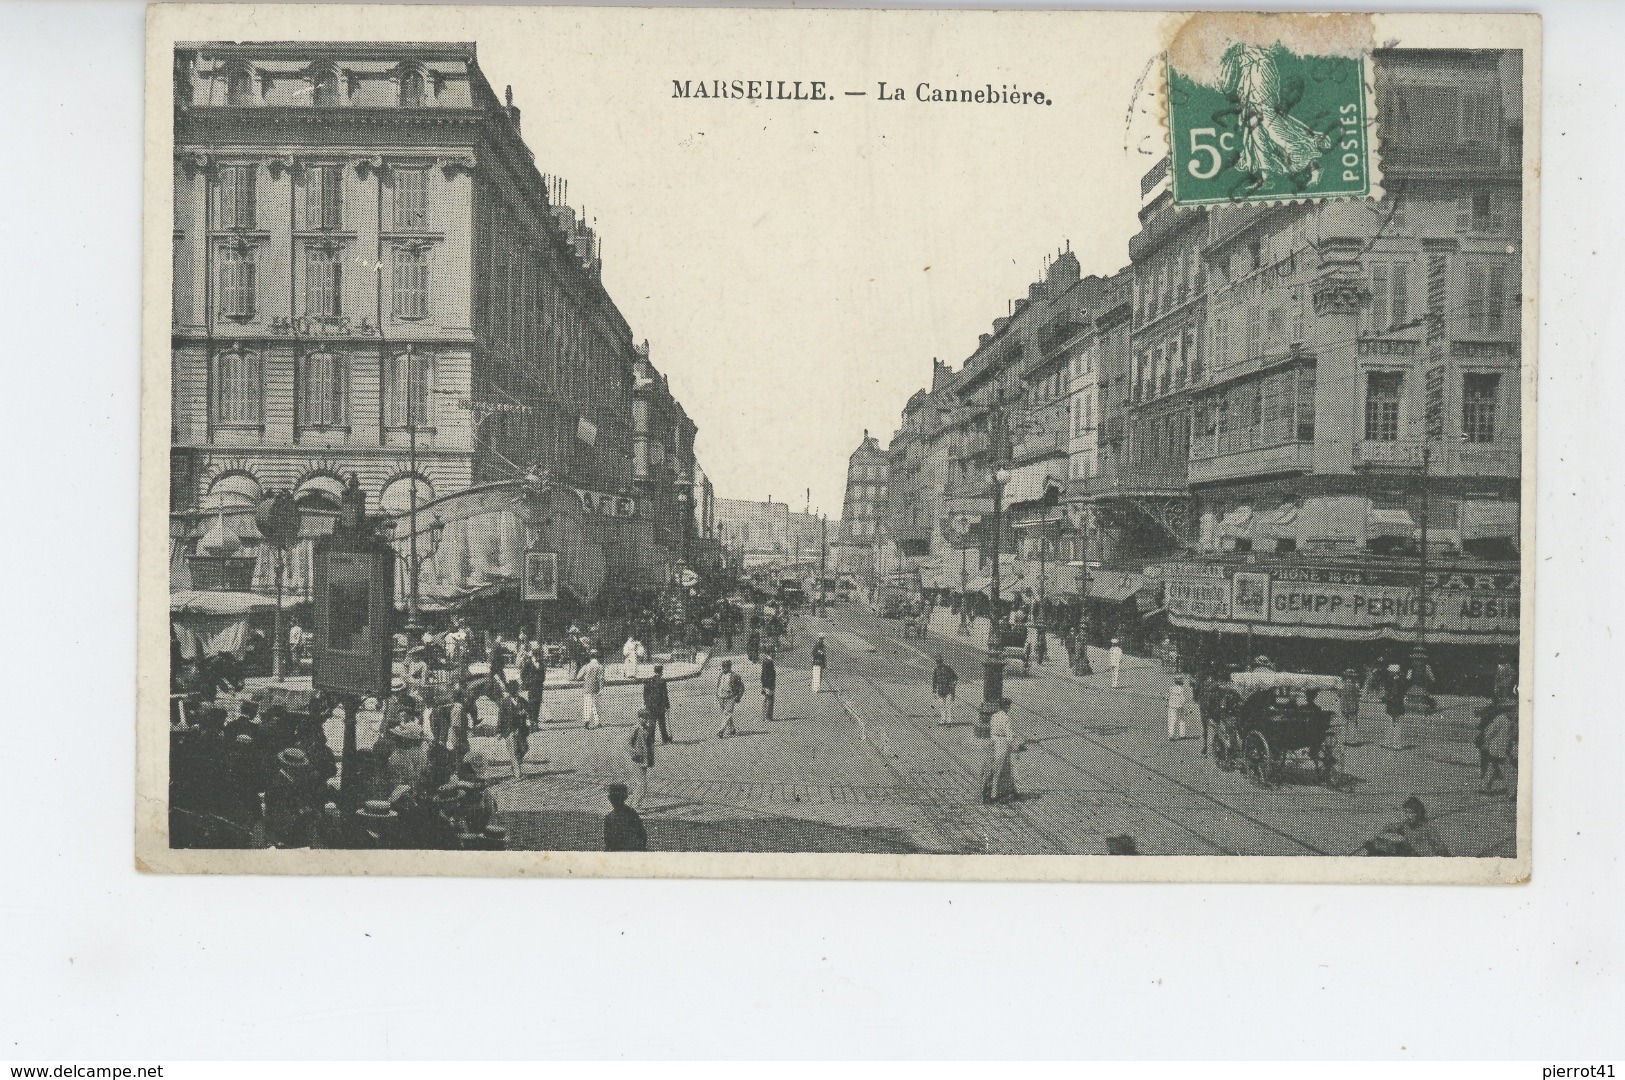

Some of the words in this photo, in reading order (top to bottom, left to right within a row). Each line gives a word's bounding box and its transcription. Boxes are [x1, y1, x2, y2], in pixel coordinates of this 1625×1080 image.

[671, 79, 836, 101] MARSEILLE.
[877, 81, 906, 102] La
[915, 82, 1053, 106] Cannebière.
[1340, 103, 1359, 182] POSTES
